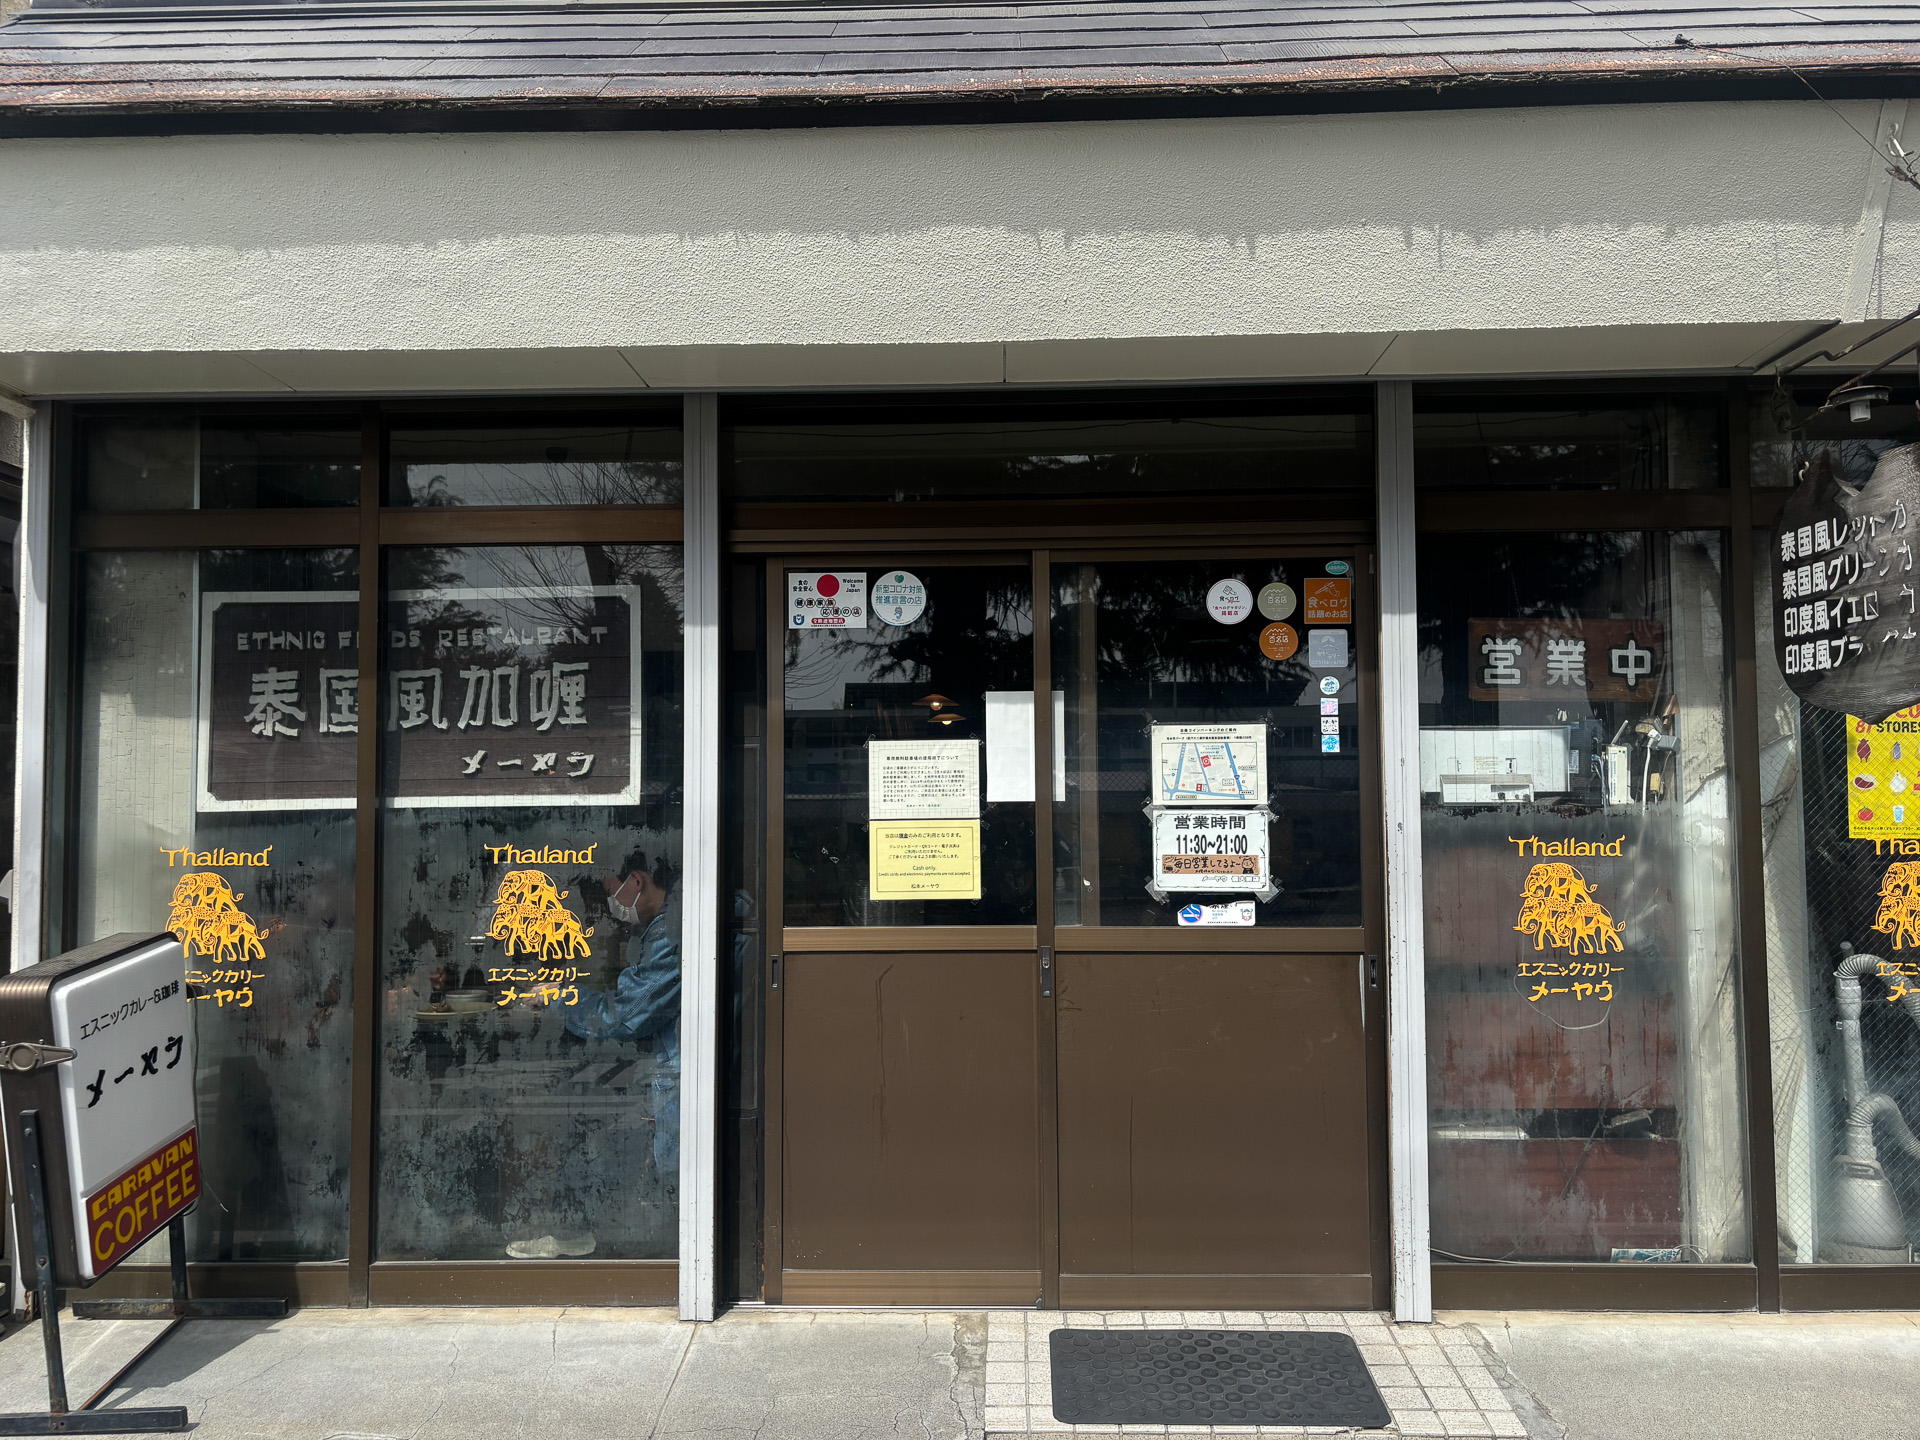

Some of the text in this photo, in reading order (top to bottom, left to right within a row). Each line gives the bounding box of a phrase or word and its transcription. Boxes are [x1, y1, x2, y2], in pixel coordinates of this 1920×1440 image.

[875, 584, 923, 594] 新型コロナ対策
[796, 598, 835, 608] 健康家族
[875, 596, 922, 605] 推進宣言の店
[1219, 595, 1239, 603] 食べログ
[1267, 596, 1287, 604] 百名店
[1307, 596, 1348, 608] 食べログ
[821, 608, 861, 617] 応援の店
[1307, 610, 1348, 618] 話題のお店
[237, 631, 326, 650] ETHNIC
[338, 629, 421, 649] FDS
[1269, 635, 1289, 644] 百名店
[1482, 637, 1652, 687] 営業中
[1174, 815, 1246, 830] 営業時間
[484, 842, 598, 864] Thailand
[1508, 834, 1626, 857] Thailand
[160, 845, 273, 867] Thailand
[487, 967, 591, 982] エスニックカリー
[1517, 962, 1625, 977] エスニックカリー
[186, 987, 254, 1007] ーヤウ
[497, 985, 579, 1006] メーヤウ
[1528, 980, 1613, 1002] メーヤウ
[80, 979, 180, 1040] エスニックカレー&珈琲
[87, 1035, 184, 1109] メーヤウ
[92, 1135, 193, 1221] CARAVAN
[94, 1159, 196, 1261] COFFEE
